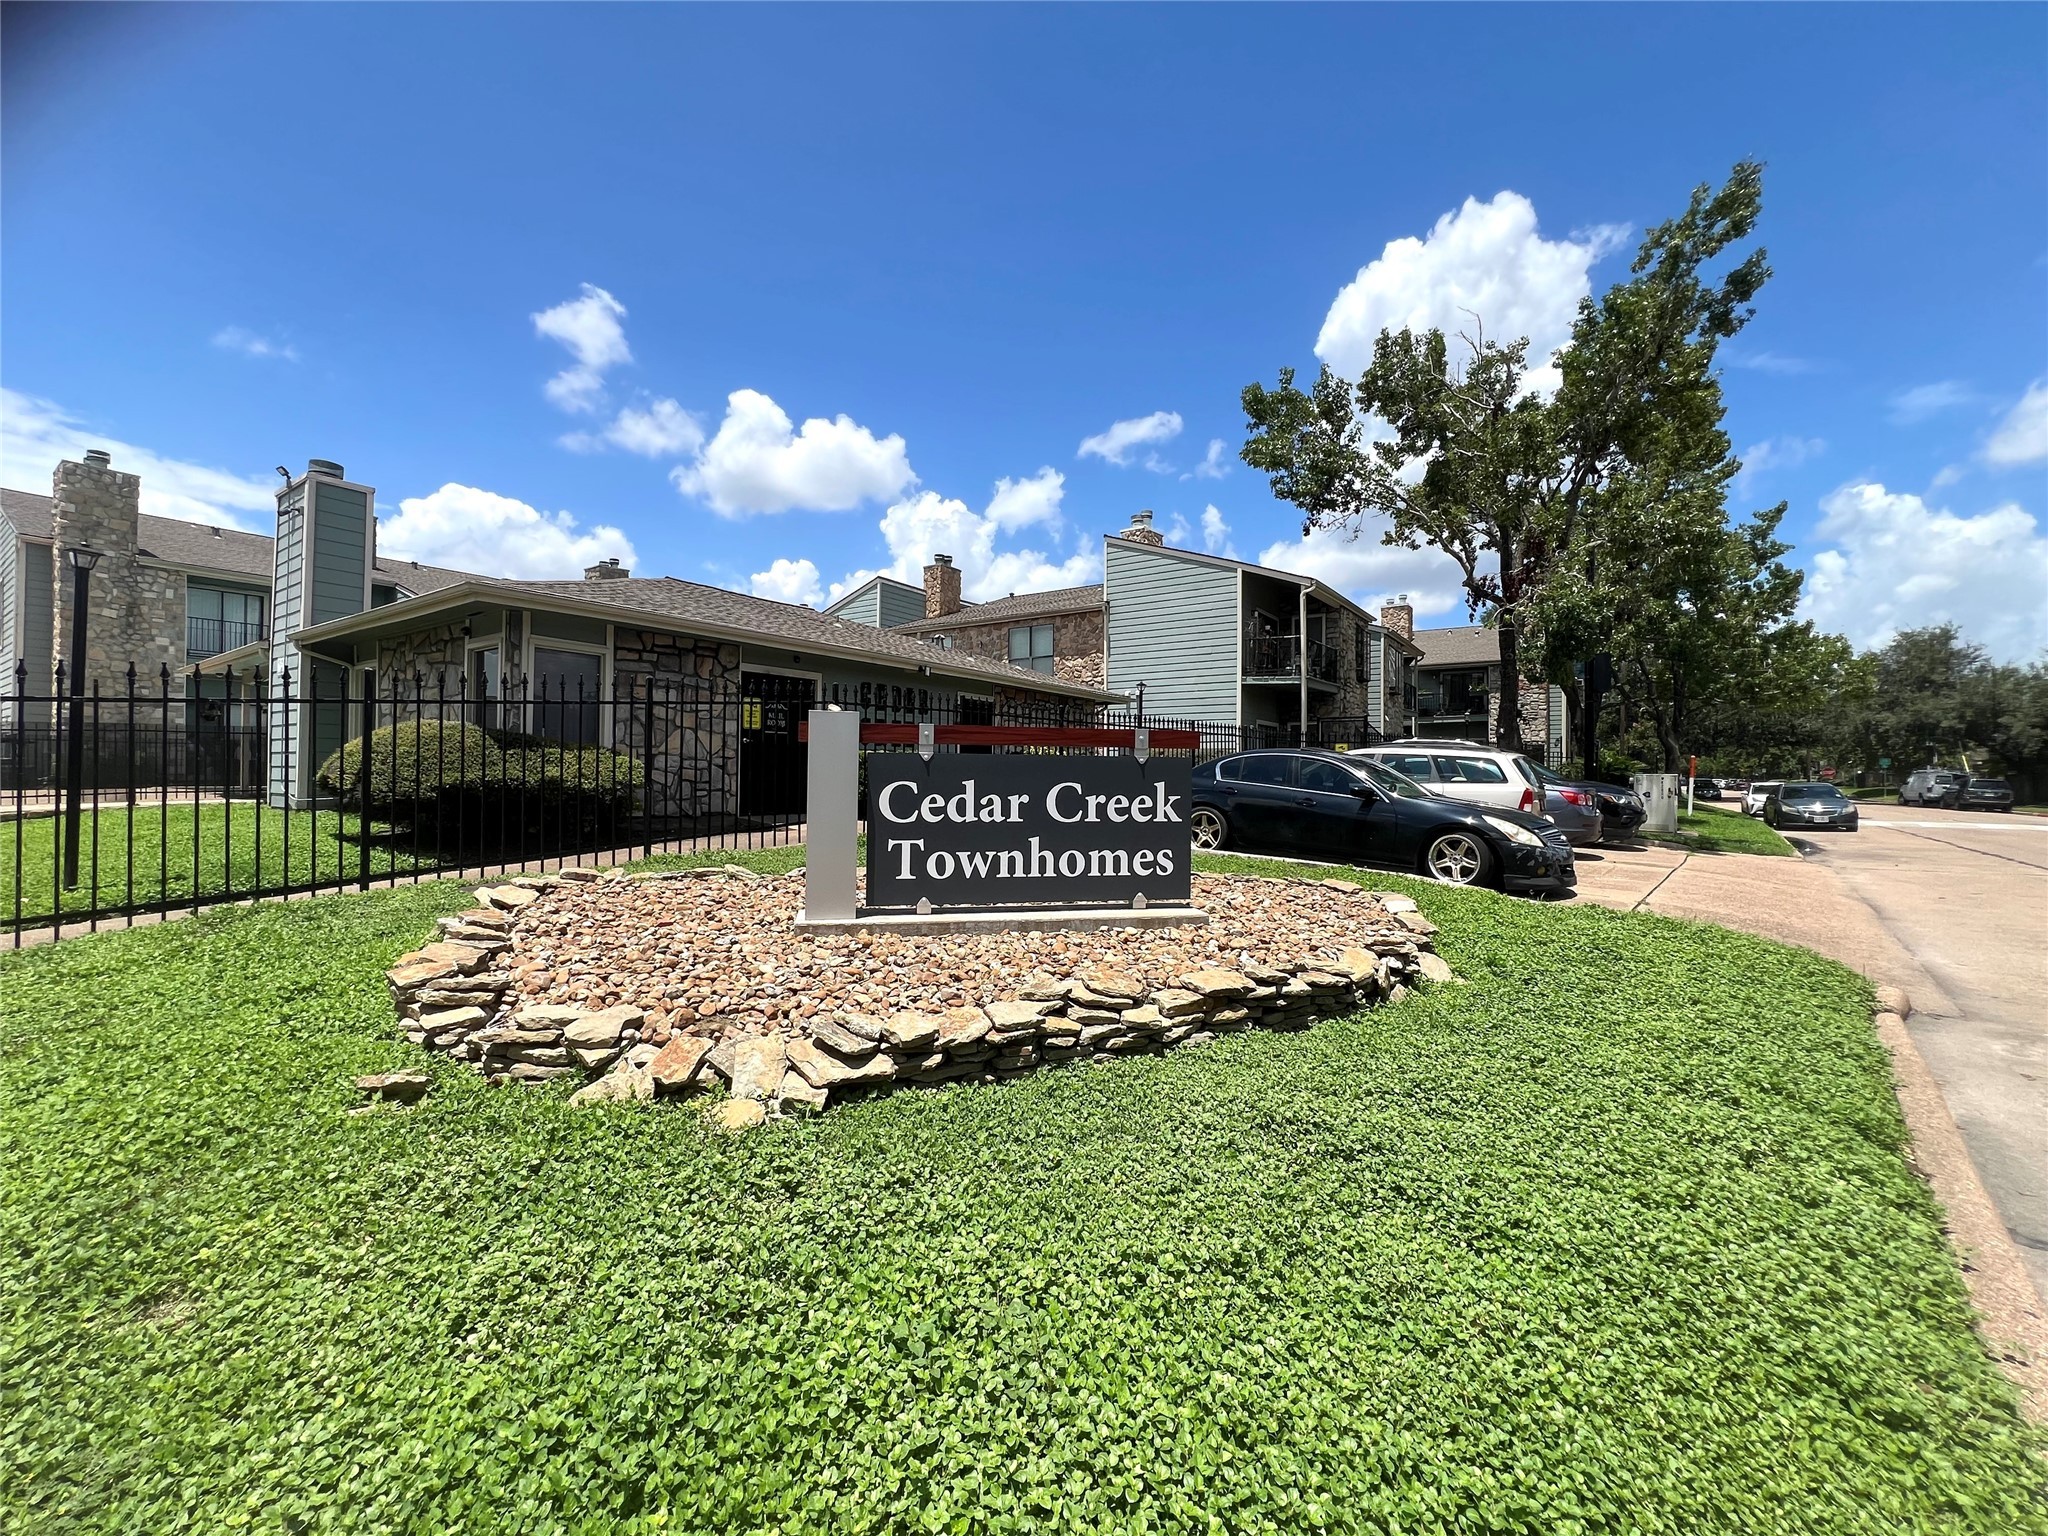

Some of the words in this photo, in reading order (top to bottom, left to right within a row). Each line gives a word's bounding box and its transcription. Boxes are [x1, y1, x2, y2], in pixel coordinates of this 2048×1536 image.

[878, 779, 1030, 824] Cedar
[1045, 781, 1183, 823] Creek
[887, 836, 1175, 880] Townhomes
